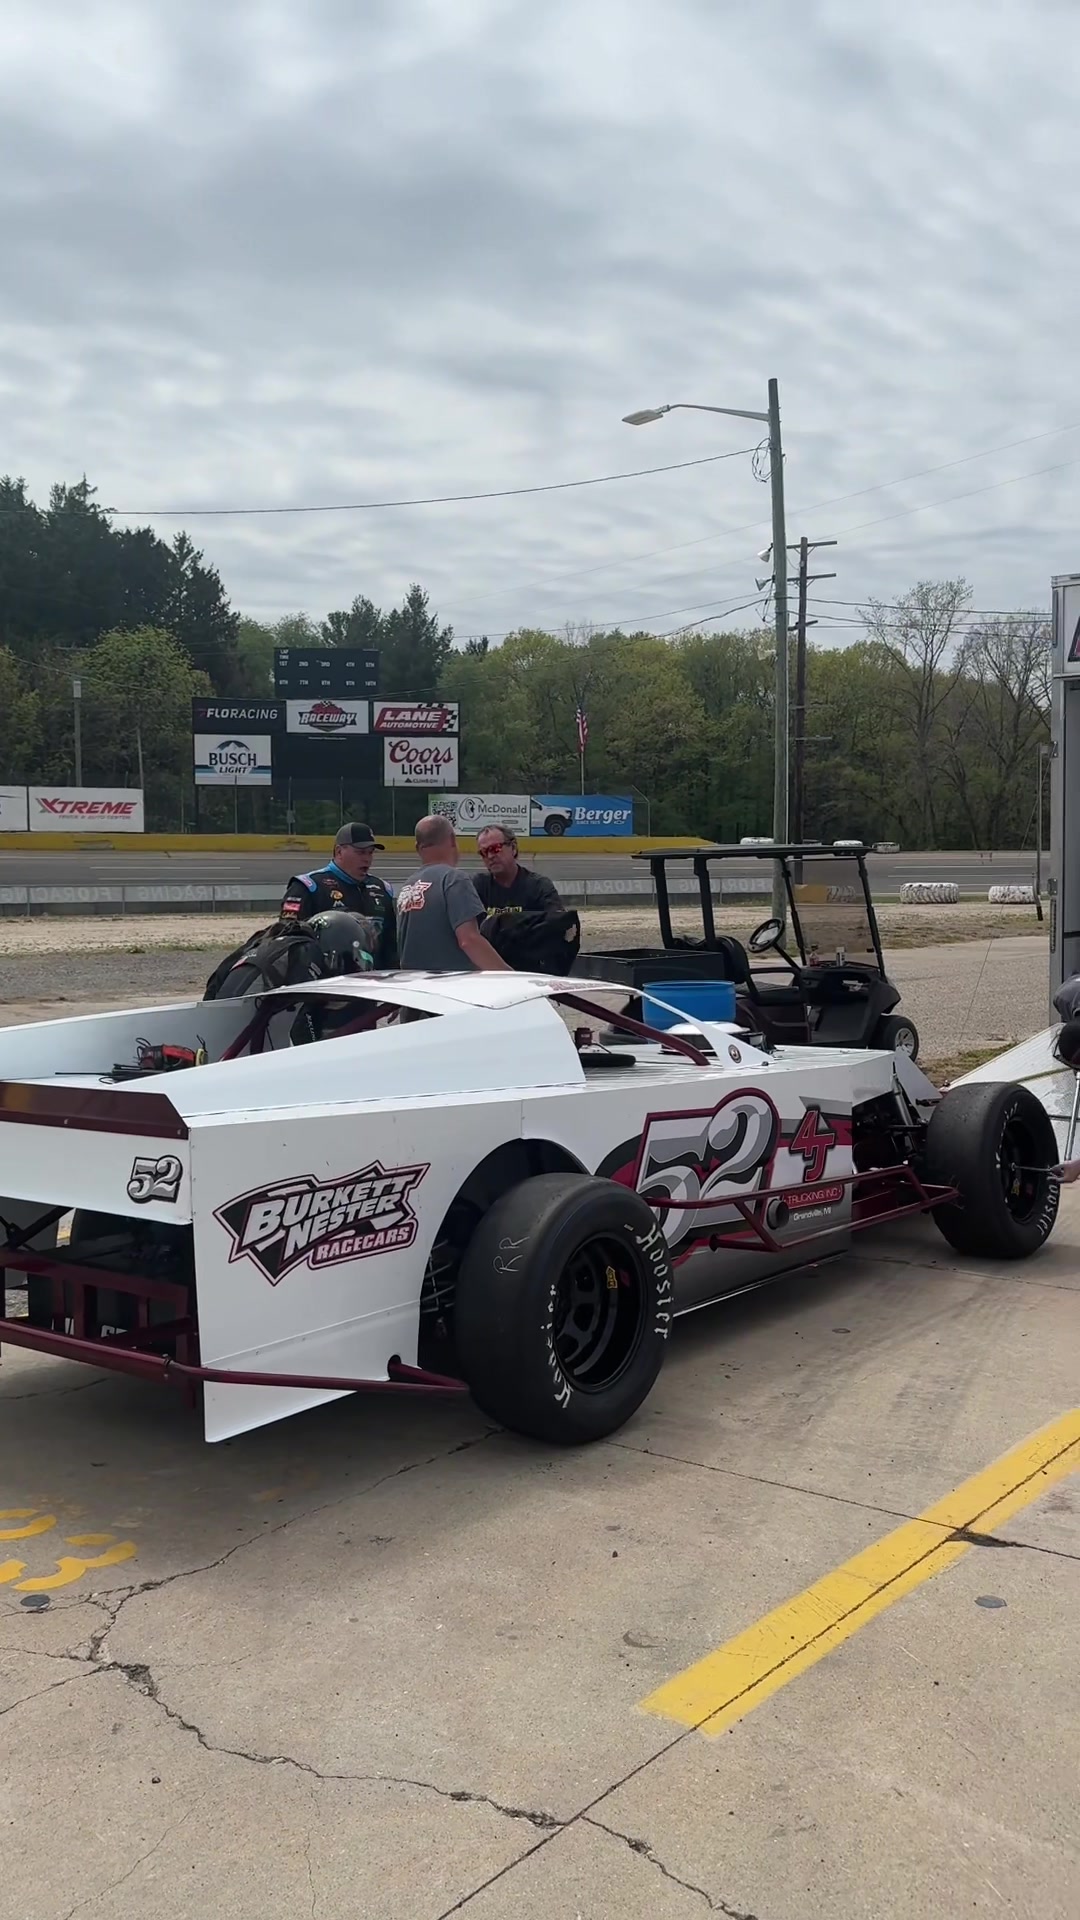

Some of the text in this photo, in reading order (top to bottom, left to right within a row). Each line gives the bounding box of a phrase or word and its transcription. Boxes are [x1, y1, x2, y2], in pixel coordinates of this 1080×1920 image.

[206, 707, 278, 720] FLORACING
[300, 711, 356, 724] RACEWAY
[383, 710, 442, 722] LANE
[379, 721, 439, 729] AUTOMOTIVE
[208, 752, 257, 767] BUSCH
[388, 739, 454, 764] Coors
[218, 766, 249, 774] LIGHT
[401, 764, 442, 776] LIGHT
[35, 797, 138, 814] XTREME
[478, 804, 527, 815] McDonald
[574, 806, 632, 825] Berger
[633, 1087, 779, 1250] 52
[126, 1154, 183, 1203] 52
[242, 1173, 415, 1247] BURKETT
[284, 1194, 402, 1261] NESTER
[315, 1225, 411, 1261] RACECARS
[635, 1222, 674, 1340] Hoosier
